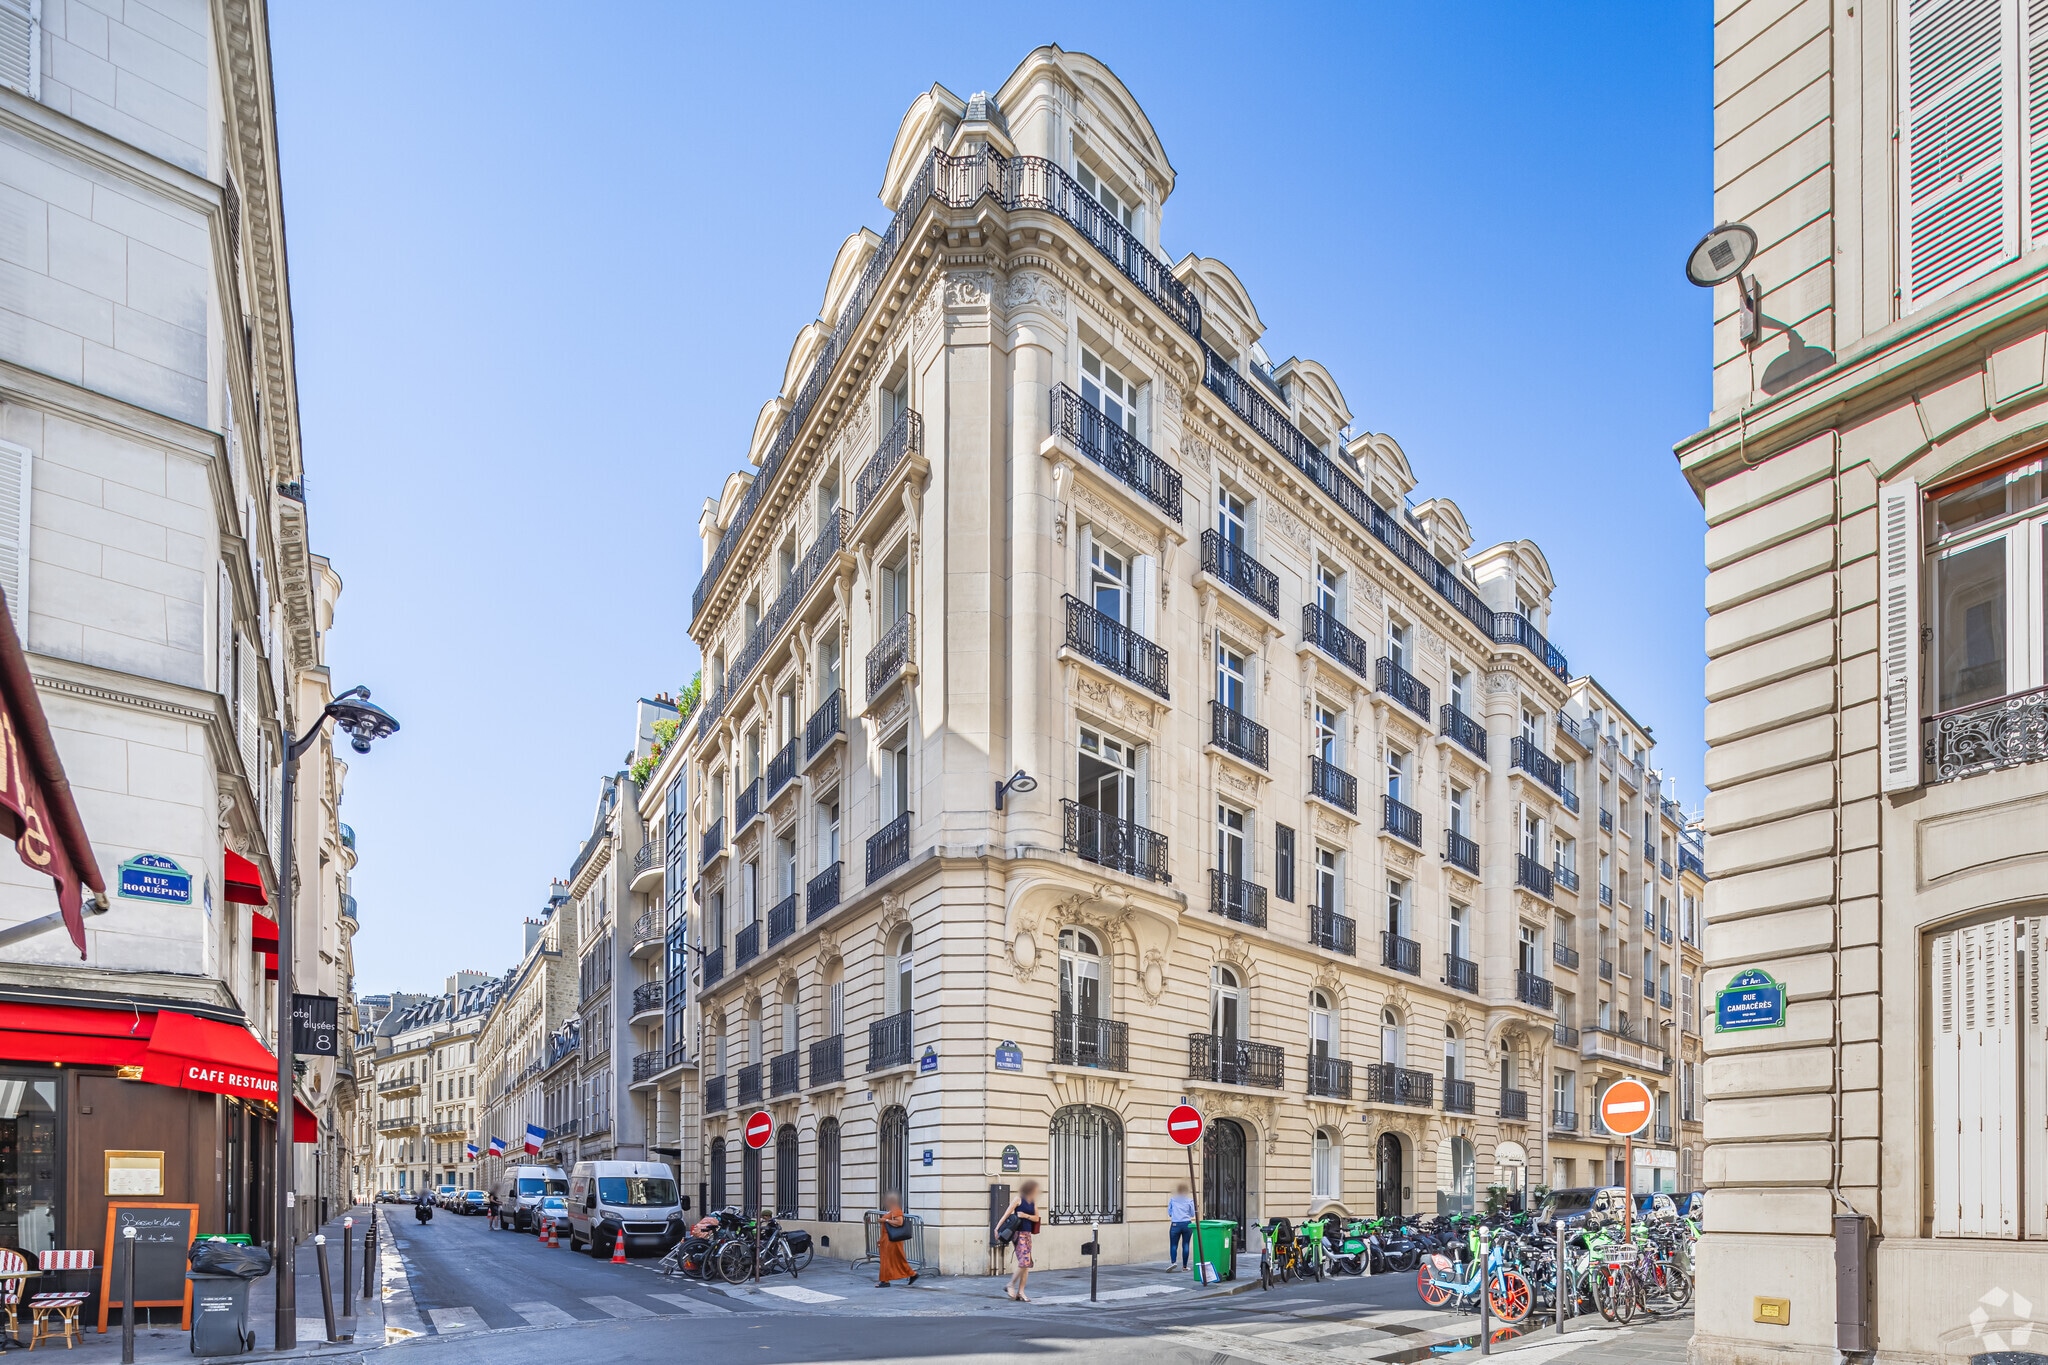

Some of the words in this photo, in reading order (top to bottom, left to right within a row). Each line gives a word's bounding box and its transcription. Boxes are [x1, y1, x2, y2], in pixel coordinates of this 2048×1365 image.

[144, 876, 168, 886] RUE
[123, 883, 188, 898] ROQUÉPINE
[293, 1005, 311, 1019] otel
[1727, 1001, 1772, 1012] CAMBACÉRÈS
[303, 1018, 336, 1031] élysées
[316, 1035, 331, 1051] 8
[188, 1067, 225, 1084] CAFE
[228, 1073, 278, 1092] RESTAUR
